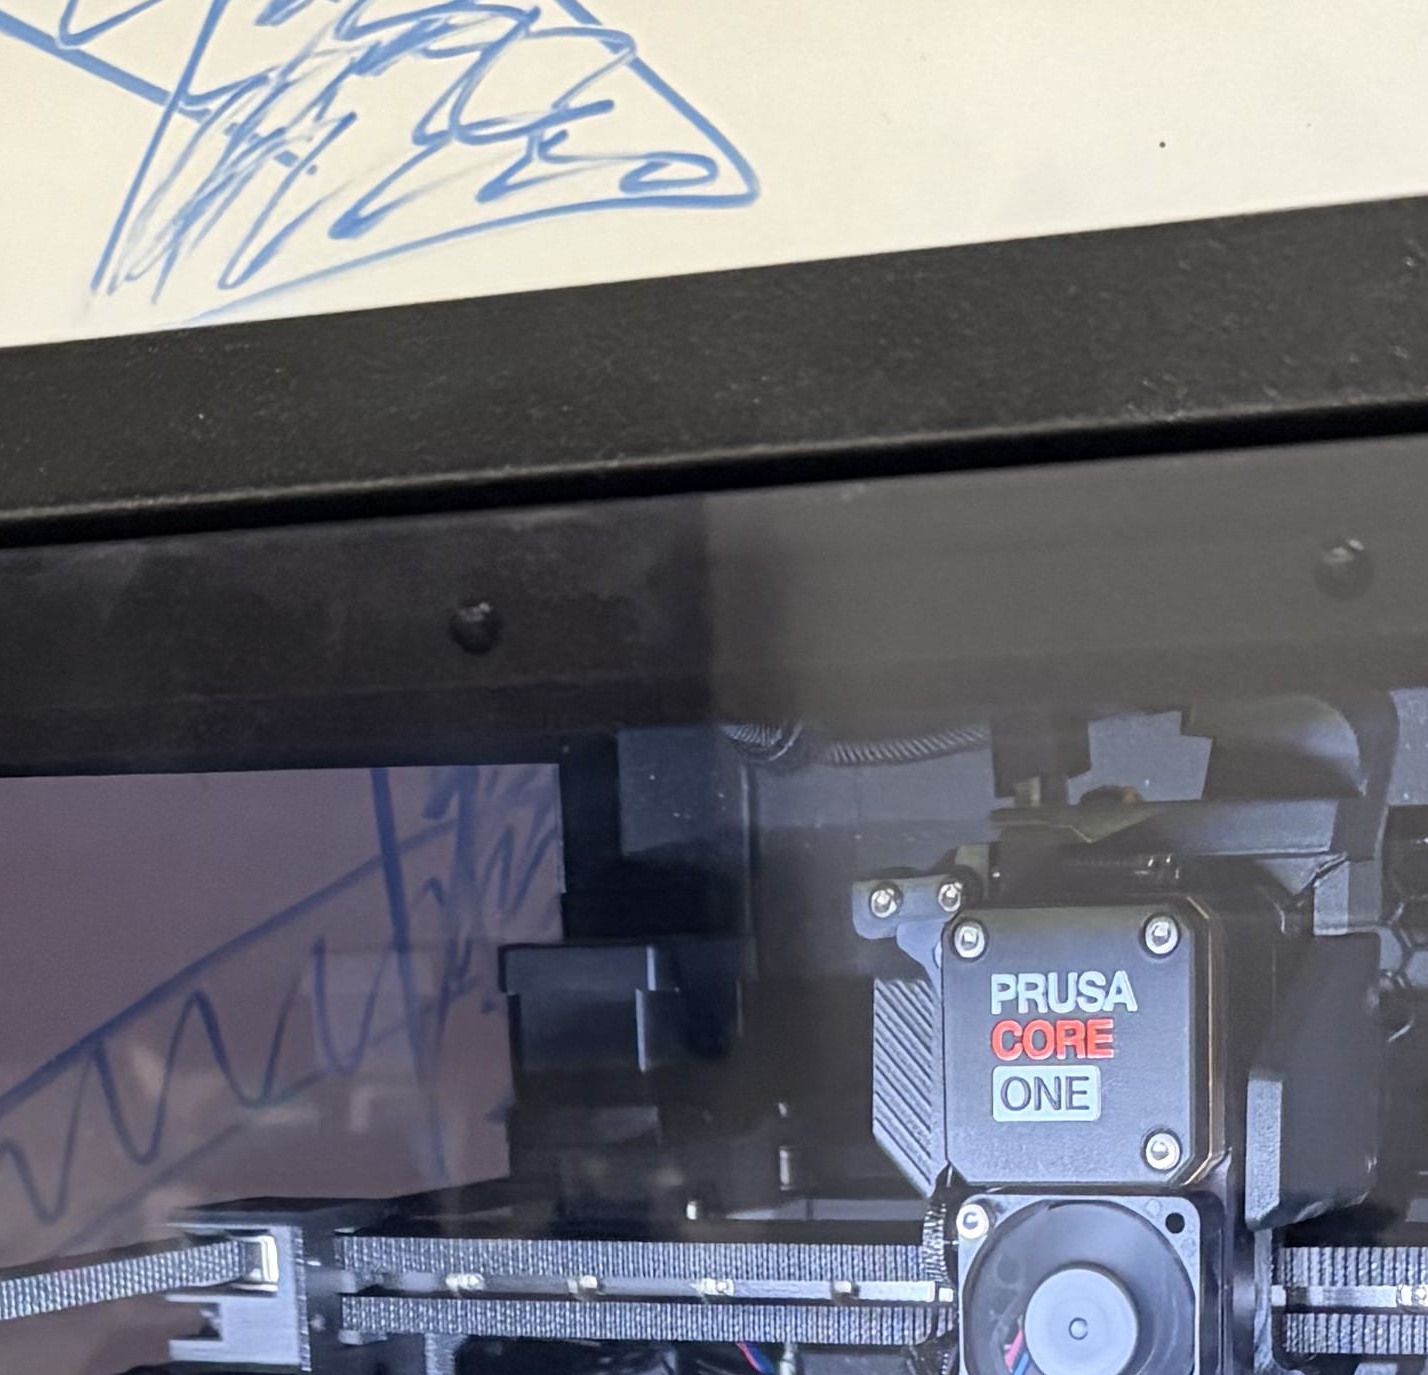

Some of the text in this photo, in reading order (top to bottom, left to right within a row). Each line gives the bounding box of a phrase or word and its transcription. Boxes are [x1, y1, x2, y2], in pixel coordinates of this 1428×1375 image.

[991, 970, 1138, 1015] PRUSA
[991, 1018, 1115, 1062] CORE
[1000, 1075, 1090, 1112] ONE
